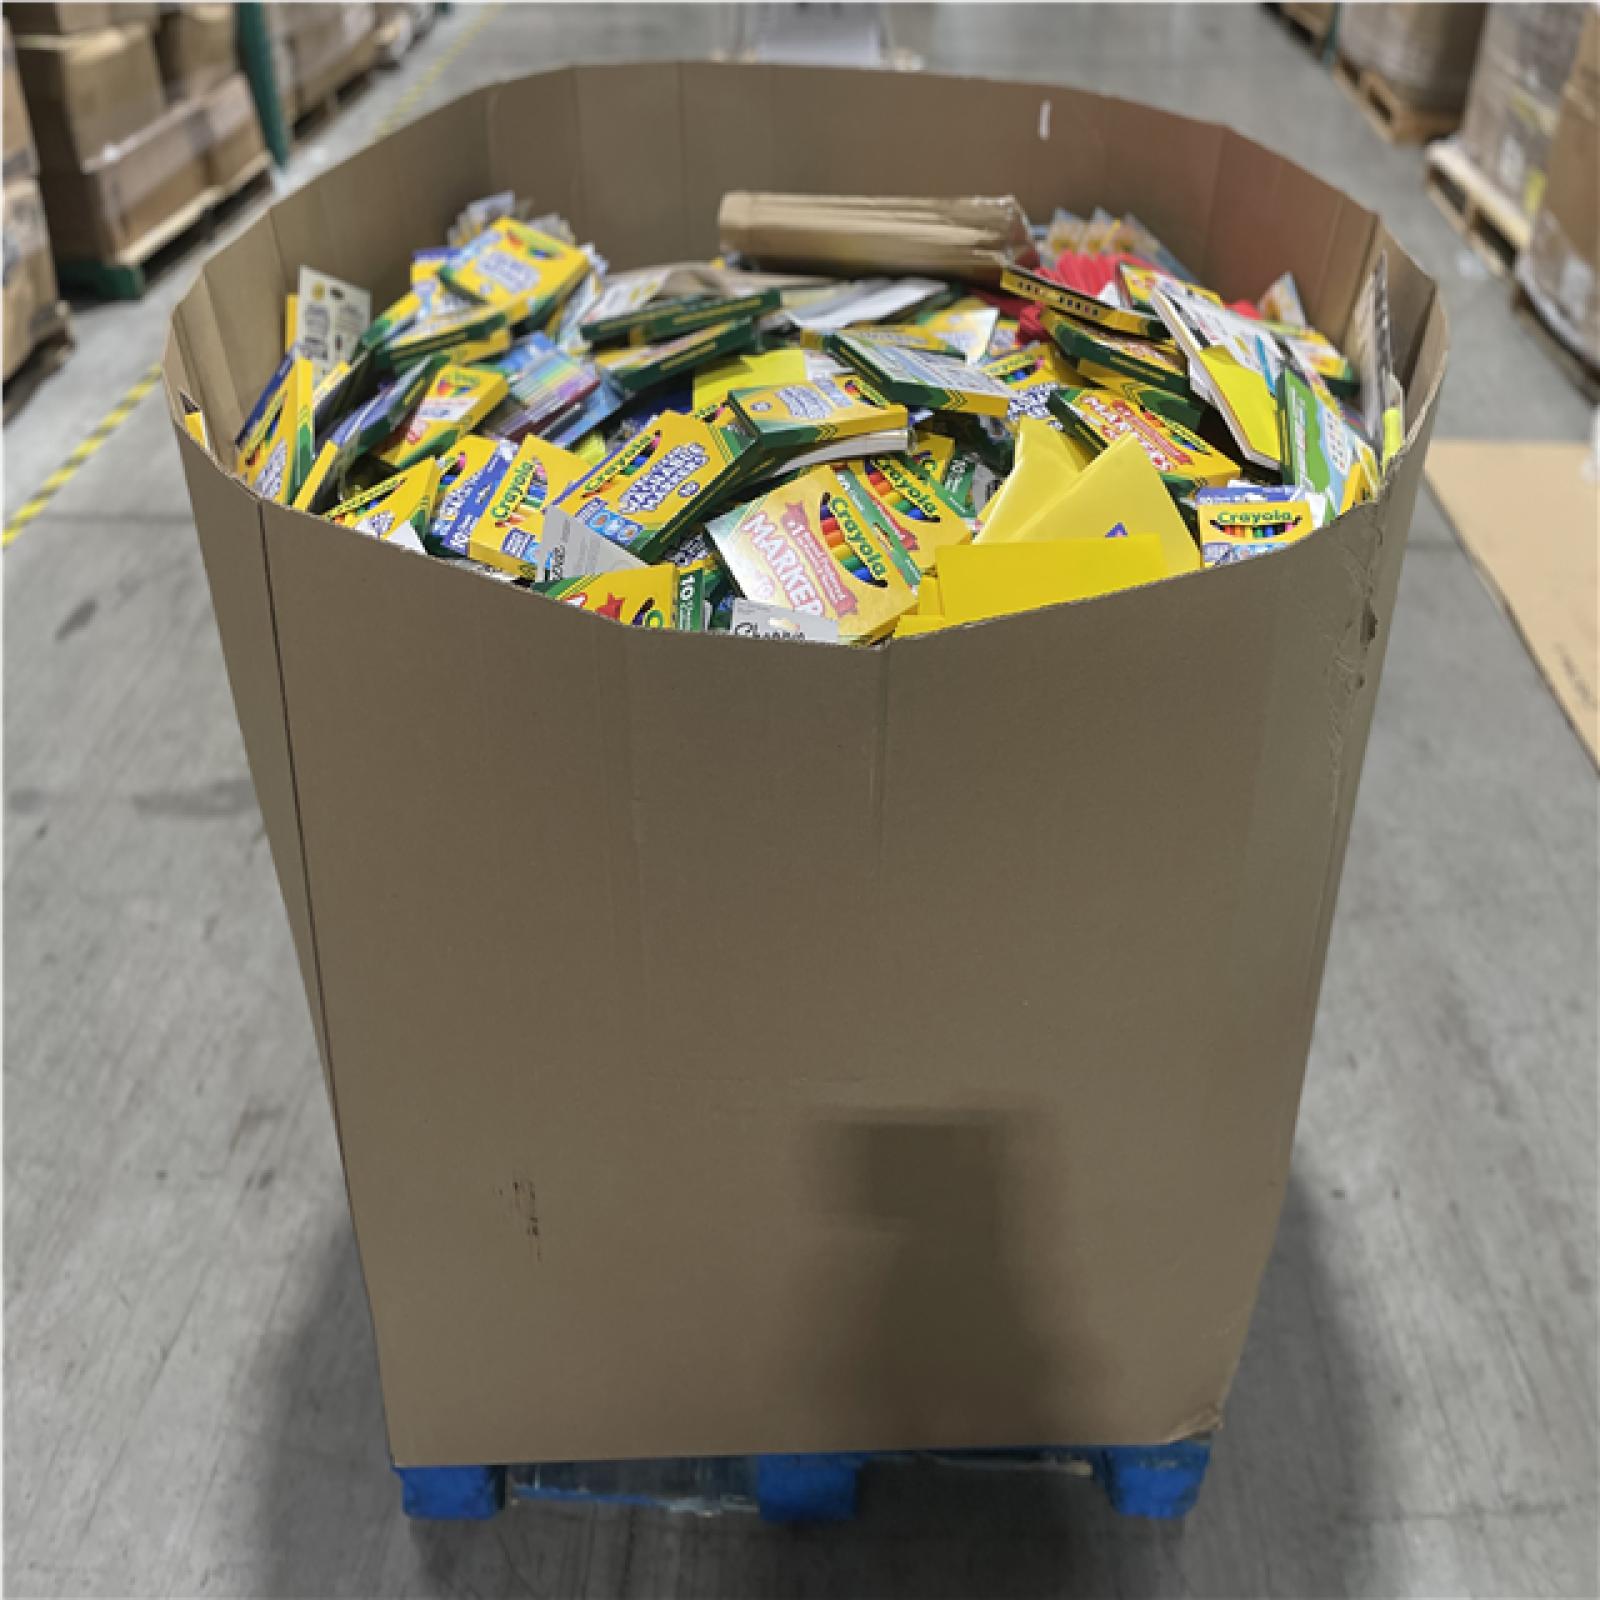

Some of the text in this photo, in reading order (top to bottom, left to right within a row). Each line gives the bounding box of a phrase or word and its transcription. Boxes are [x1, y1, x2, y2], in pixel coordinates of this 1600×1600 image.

[491, 461, 534, 519] Crayola
[583, 433, 652, 491] Crayola
[873, 457, 937, 515] Crayola
[830, 495, 888, 578] Crayola
[1217, 509, 1291, 523] Crayola
[679, 575, 694, 601] 10
